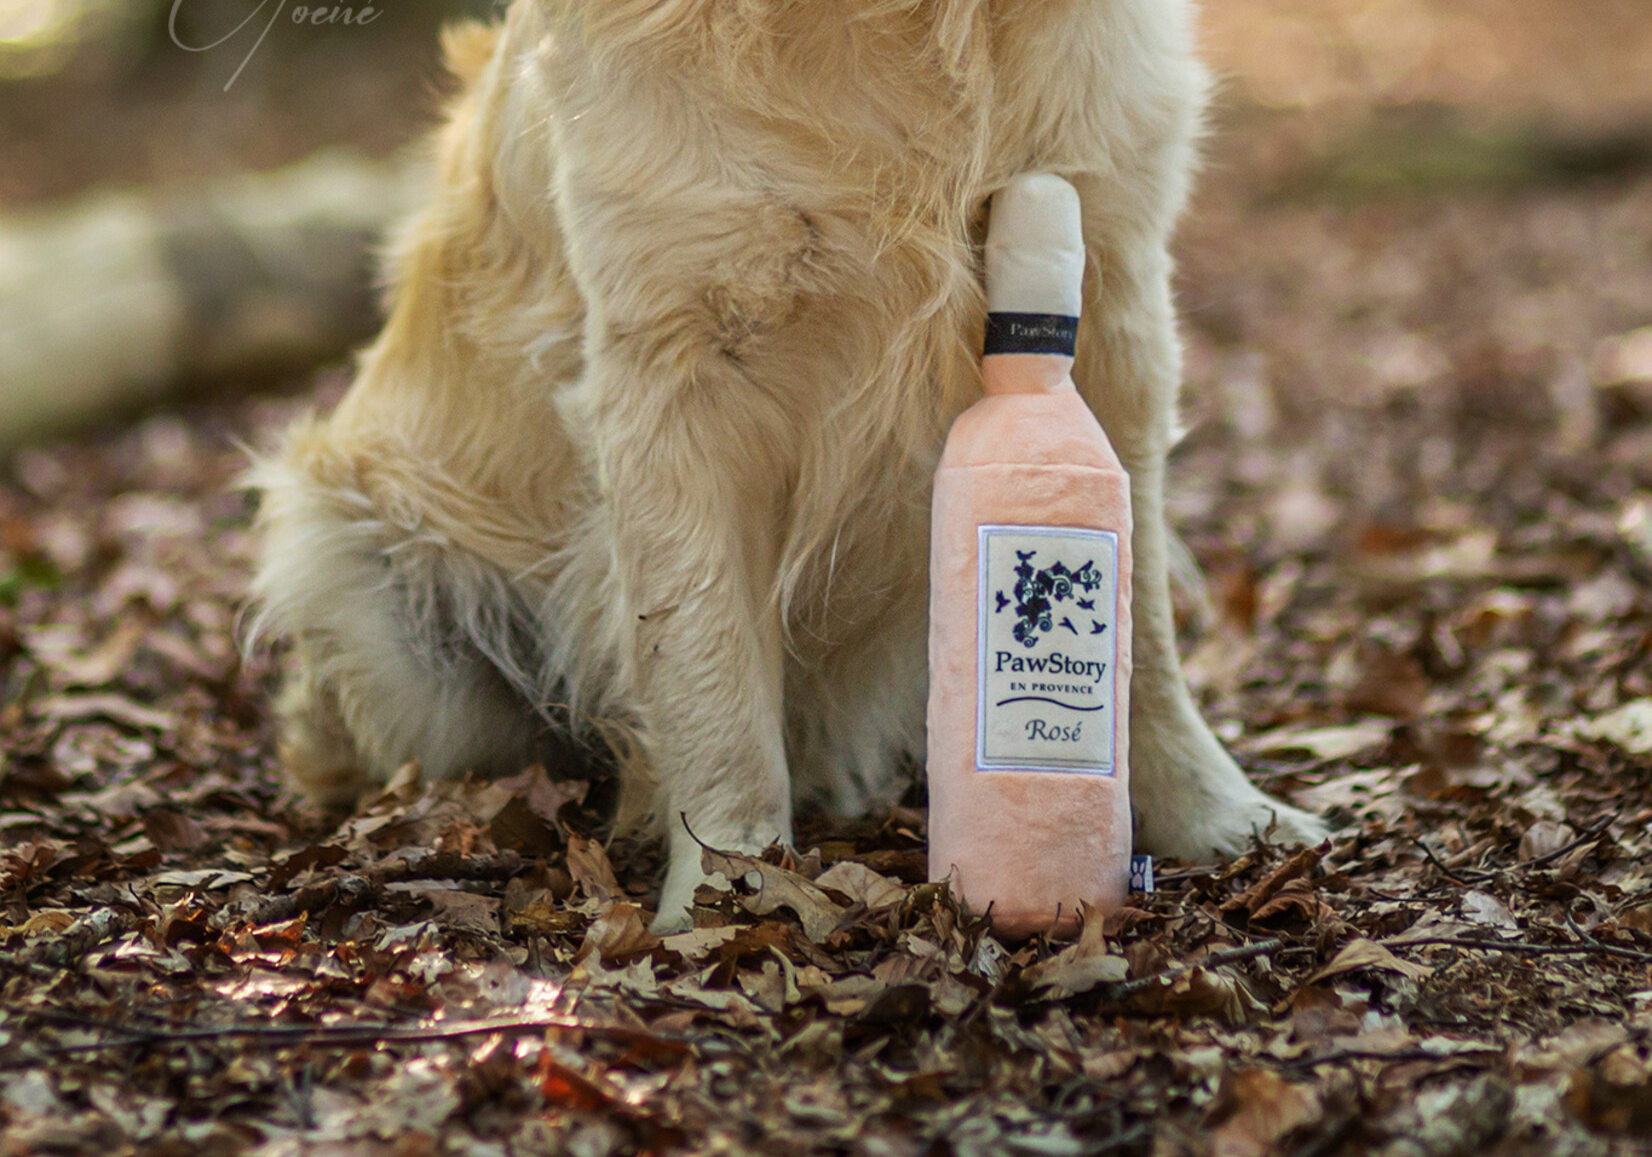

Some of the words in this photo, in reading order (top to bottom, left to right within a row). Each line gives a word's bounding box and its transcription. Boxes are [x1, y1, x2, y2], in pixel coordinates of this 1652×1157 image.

[995, 651, 1106, 683] PawStory
[1010, 682, 1027, 691] EN
[1032, 683, 1093, 694] PROVENCE
[1025, 719, 1083, 742] Rosé
